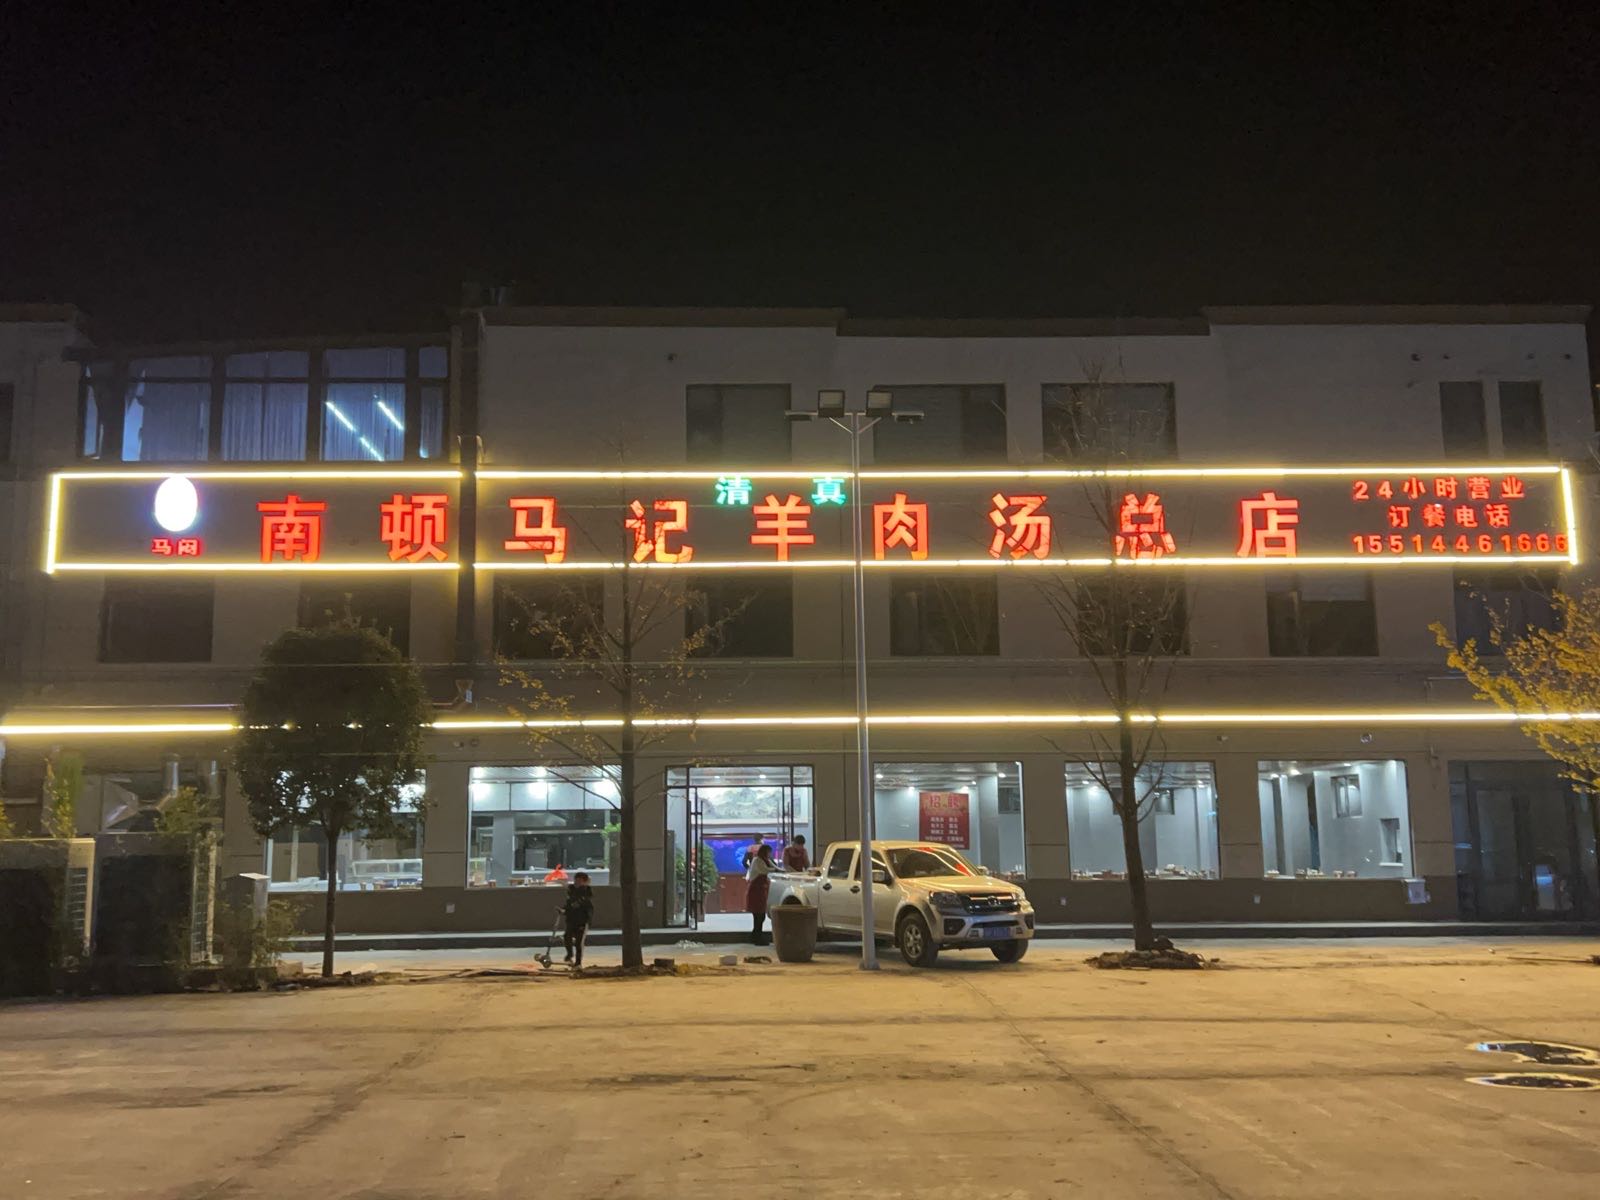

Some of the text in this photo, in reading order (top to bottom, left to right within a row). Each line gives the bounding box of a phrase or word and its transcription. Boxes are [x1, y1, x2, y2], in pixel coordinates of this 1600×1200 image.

[714, 477, 848, 506] 清真
[1353, 476, 1525, 500] 24小时营业
[258, 492, 1300, 562] 南顿马记羊肉汤总店
[1388, 503, 1509, 528] 订餐电话
[1353, 533, 1568, 554] 15514461666
